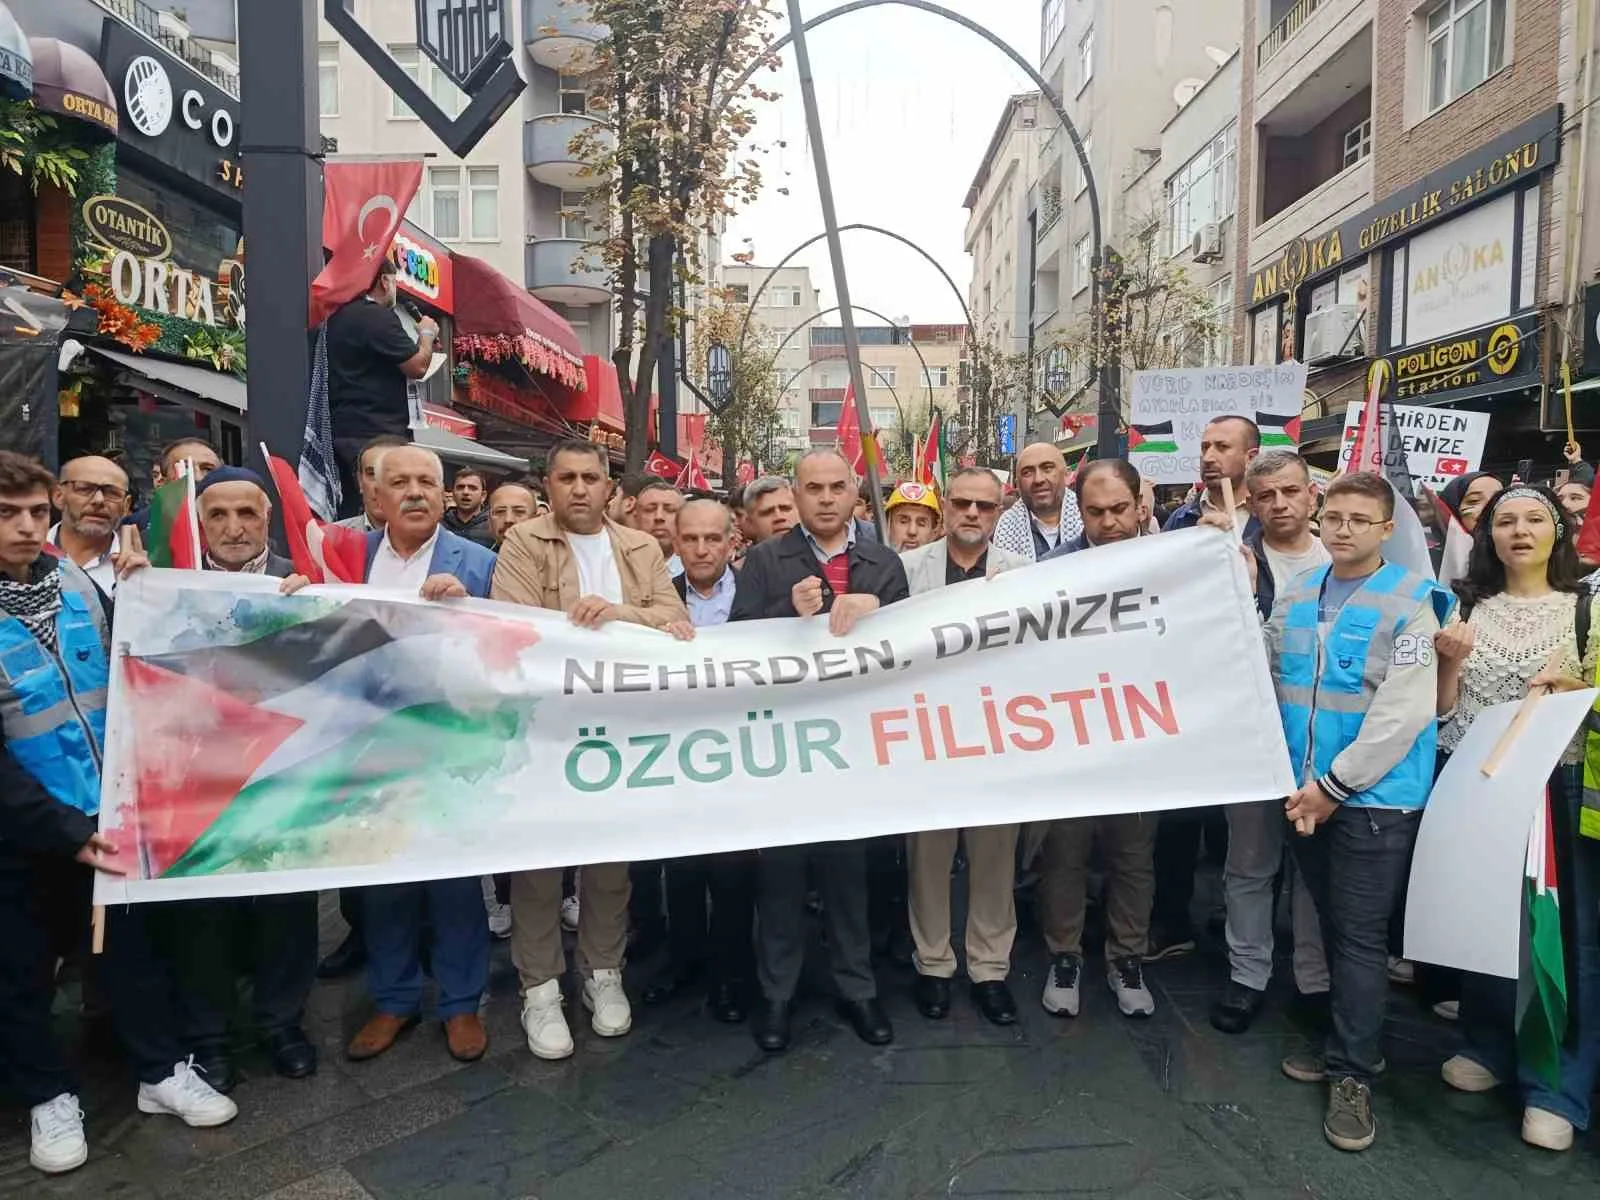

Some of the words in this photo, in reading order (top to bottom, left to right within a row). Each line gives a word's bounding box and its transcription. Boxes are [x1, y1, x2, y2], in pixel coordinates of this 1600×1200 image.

[63, 93, 102, 121] ORTA
[1359, 189, 1443, 250] GÜZELLİK
[1449, 142, 1540, 205] SALONU
[95, 205, 162, 247] OTANTİK
[111, 250, 216, 328] ORTA
[1397, 338, 1478, 377] POLİGON
[930, 586, 1168, 661] DENİZE;
[1393, 632, 1433, 667] 26
[564, 709, 850, 793] ÖZGÜR
[869, 671, 1180, 766] FİLİSTİN
